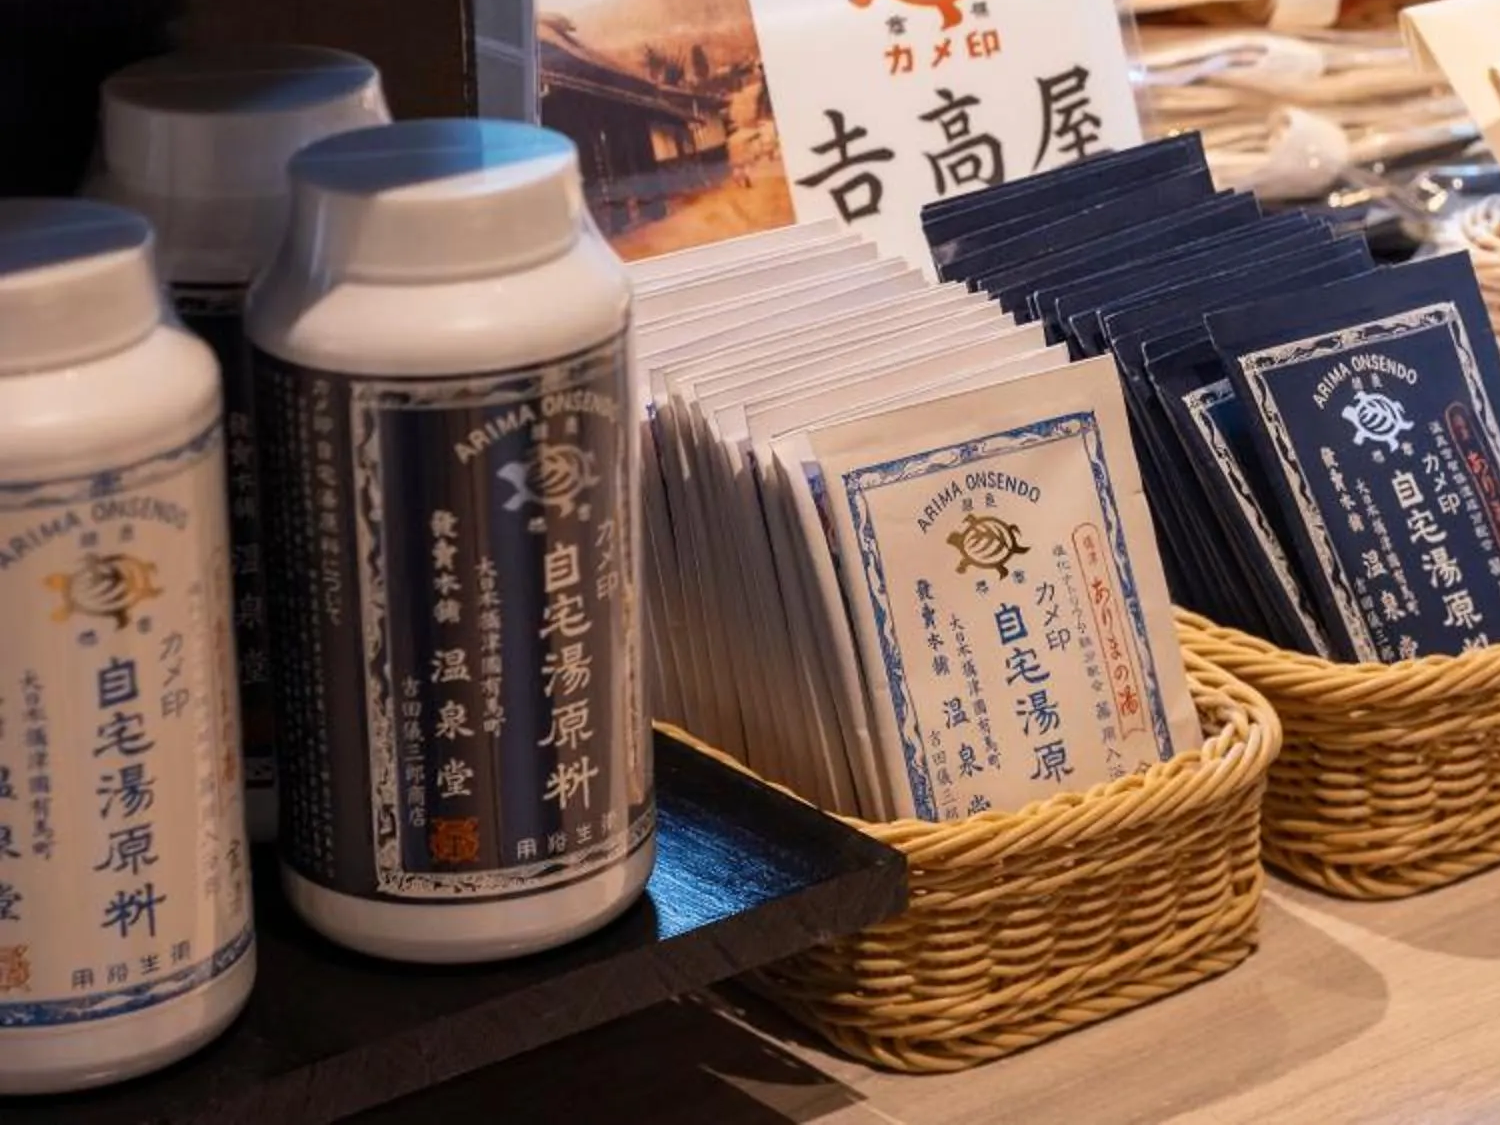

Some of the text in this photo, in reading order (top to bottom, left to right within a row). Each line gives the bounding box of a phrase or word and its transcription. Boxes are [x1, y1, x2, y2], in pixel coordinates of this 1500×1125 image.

[884, 29, 1001, 76] カメ印
[1312, 362, 1352, 409] ARIMA
[1351, 353, 1418, 385] ONSENDO
[454, 404, 537, 464] ARIMA
[917, 479, 963, 534] ARIMA
[965, 471, 1042, 504] ONSENDO
[1421, 452, 1462, 516] カメ印
[0, 509, 82, 571] ARIMA
[595, 518, 619, 601] カメ印
[1035, 581, 1072, 651] カメ印
[158, 630, 190, 720] カメ印
[537, 541, 601, 810] 自宅湯原料
[92, 655, 167, 941] 自宅湯原料
